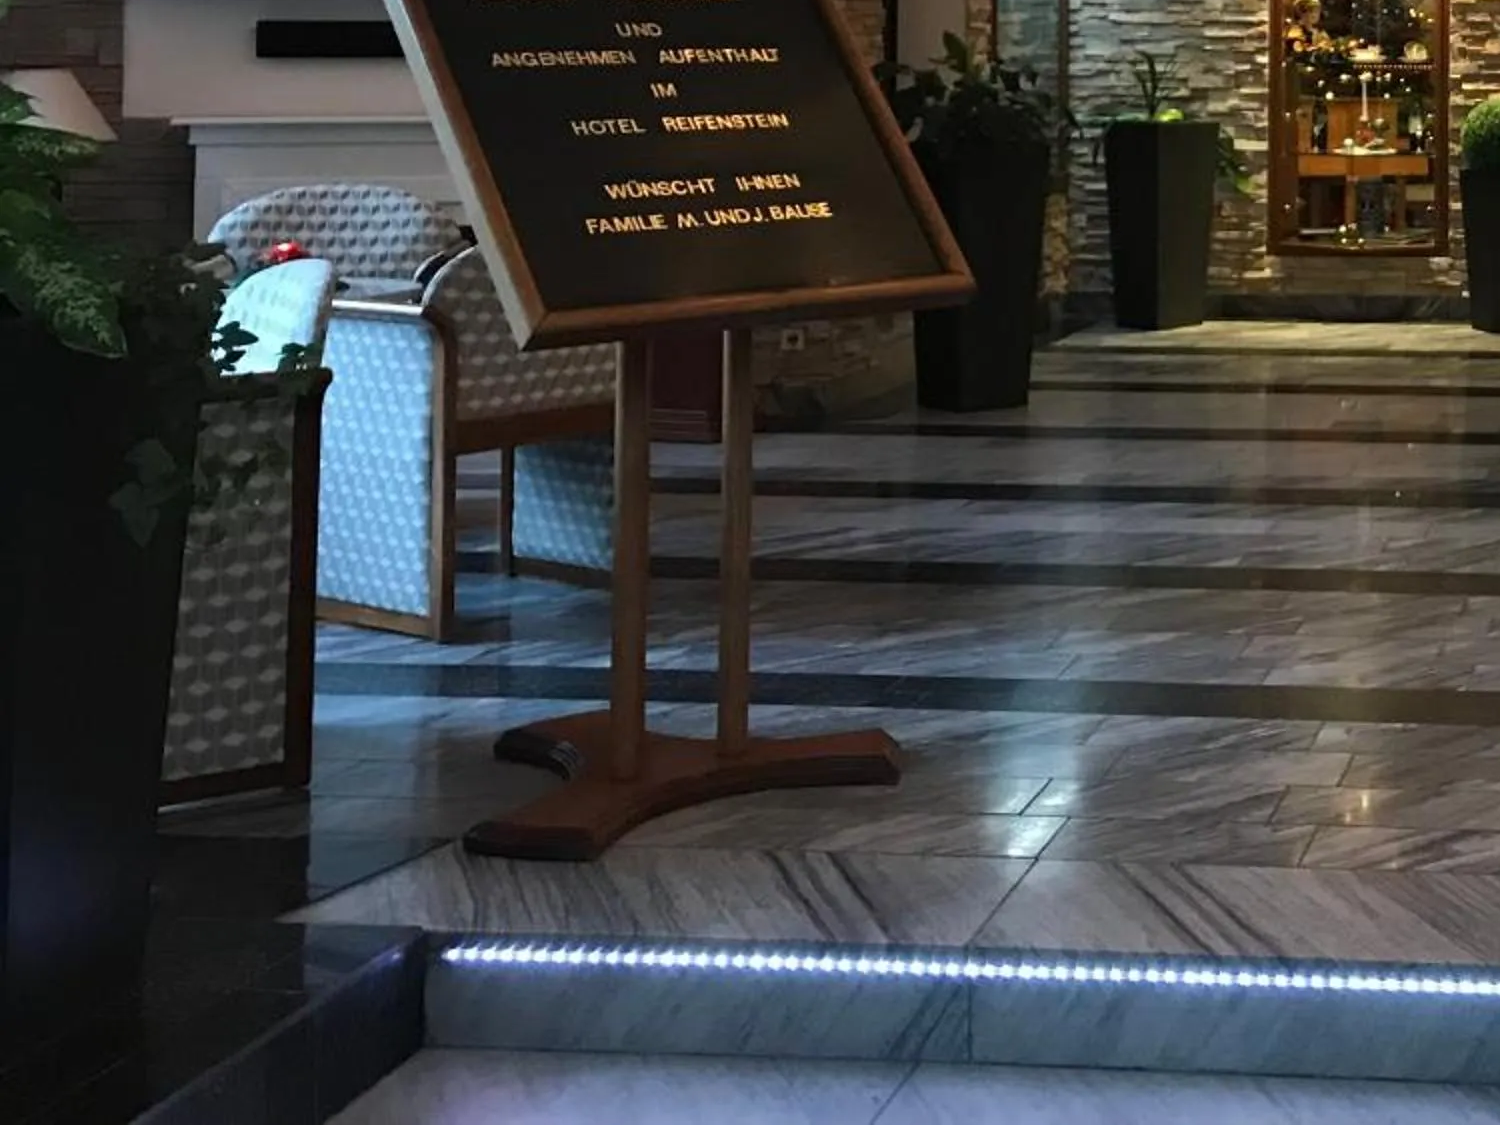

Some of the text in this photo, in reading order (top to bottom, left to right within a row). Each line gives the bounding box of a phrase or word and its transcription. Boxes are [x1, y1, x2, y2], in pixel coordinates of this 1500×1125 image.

[615, 22, 663, 37] UND
[491, 47, 779, 68] ANGENEHMEN AUFENTHALT
[650, 83, 678, 98] IM
[571, 113, 789, 137] HOTEL REIFENSTEIN
[604, 174, 800, 200] WÜNSCHT IHNEN
